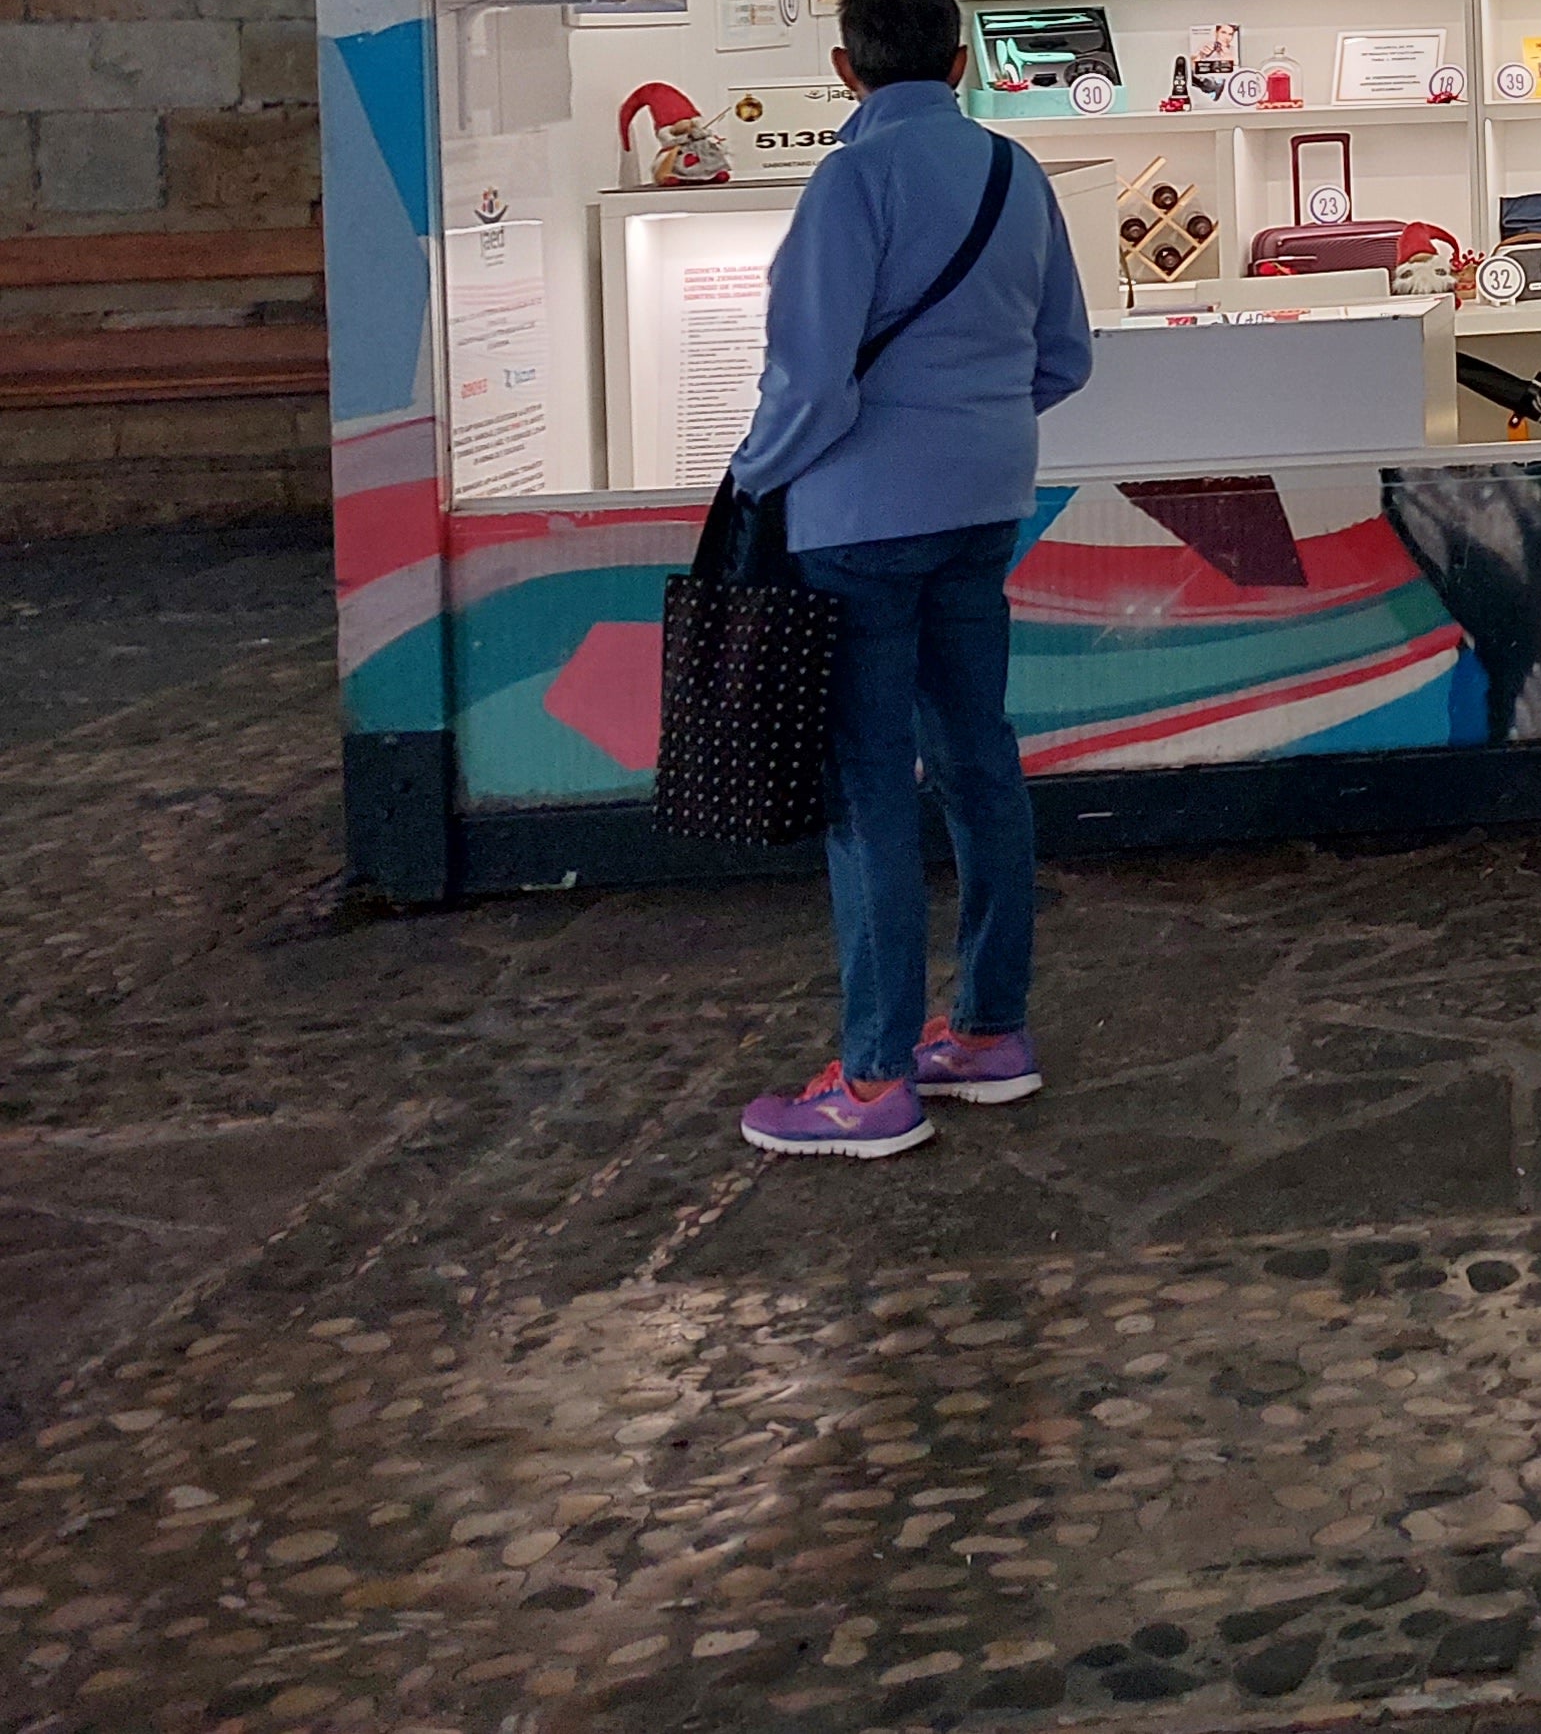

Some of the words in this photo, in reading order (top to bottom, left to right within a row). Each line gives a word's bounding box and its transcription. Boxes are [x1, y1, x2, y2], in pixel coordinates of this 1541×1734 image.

[1237, 79, 1257, 98] 46
[1439, 75, 1454, 93] 18
[1506, 73, 1524, 91] 39
[827, 86, 852, 103] jae
[1082, 85, 1101, 105] 30
[755, 130, 839, 149] 51.38
[1320, 196, 1338, 216] 23
[1490, 268, 1513, 291] 32
